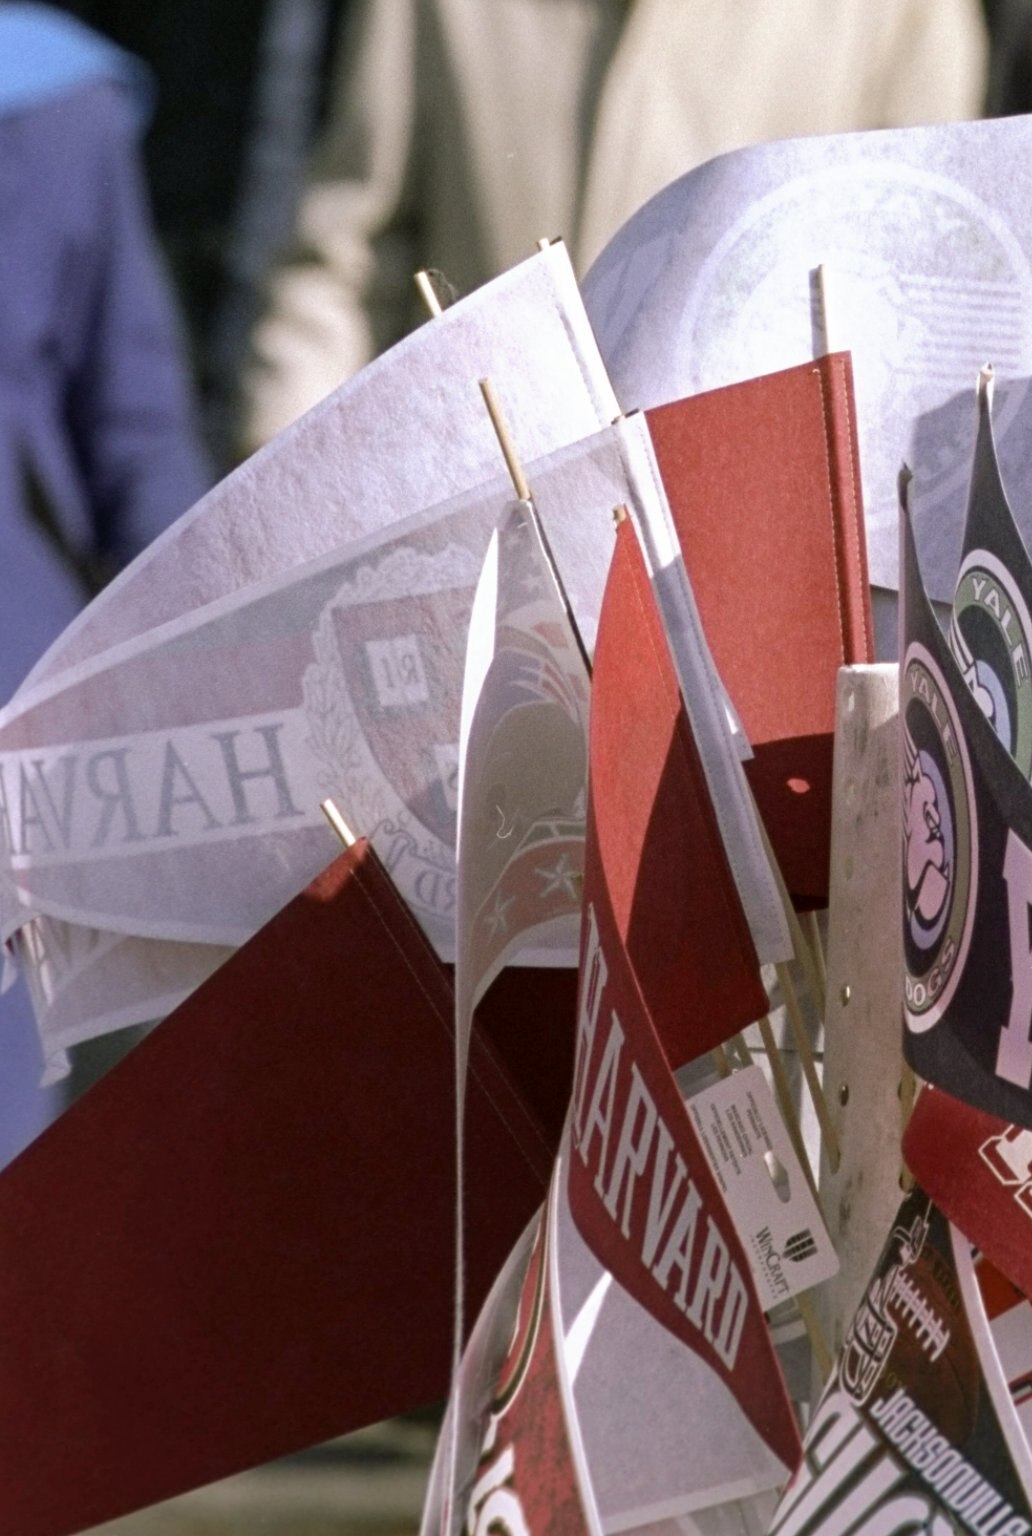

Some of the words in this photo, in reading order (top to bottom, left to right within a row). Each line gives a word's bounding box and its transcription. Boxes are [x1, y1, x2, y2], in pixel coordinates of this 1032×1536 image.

[972, 577, 1030, 689] YALE
[910, 669, 959, 767] YALE
[573, 901, 749, 1372] HARVARD
[869, 1387, 1031, 1536] JACKSONVILLE
